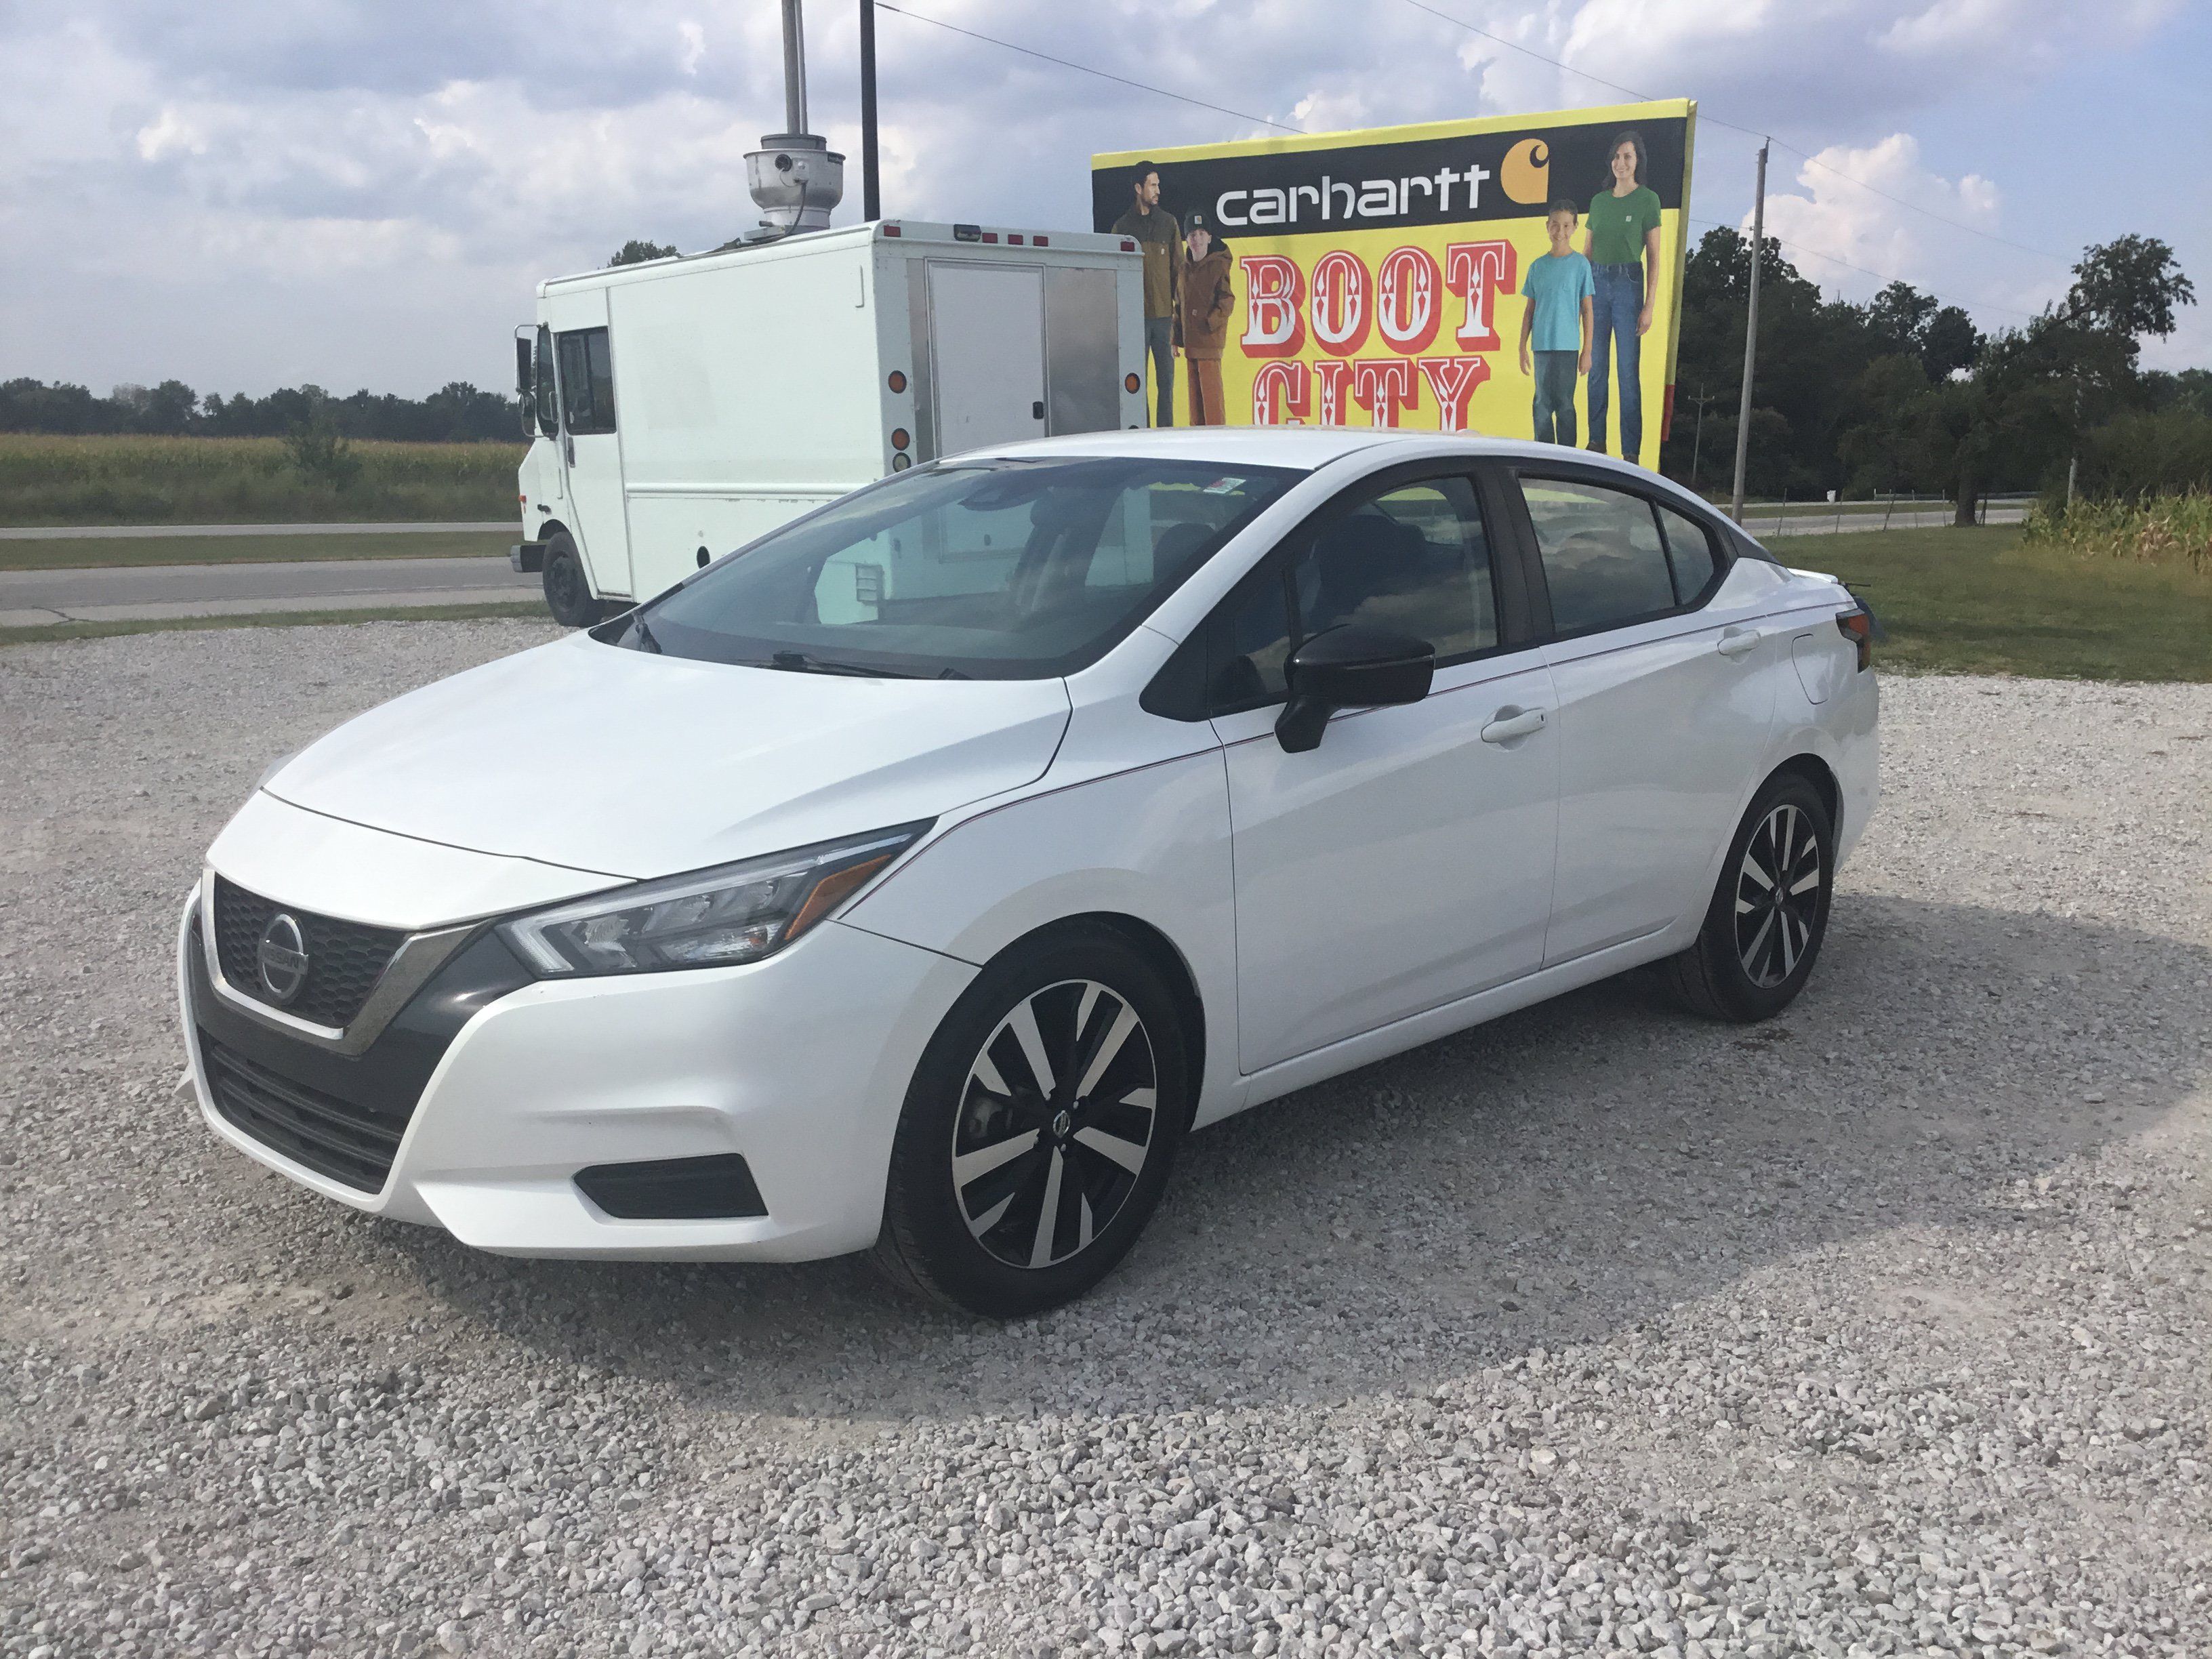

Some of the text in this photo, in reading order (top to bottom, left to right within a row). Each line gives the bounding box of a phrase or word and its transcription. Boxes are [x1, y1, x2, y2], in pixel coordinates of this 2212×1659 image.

[1216, 164, 1490, 226] carhartt
[1239, 239, 1517, 359] BOOT
[1252, 354, 1491, 432] CITY
[262, 946, 299, 969] NISSAN
